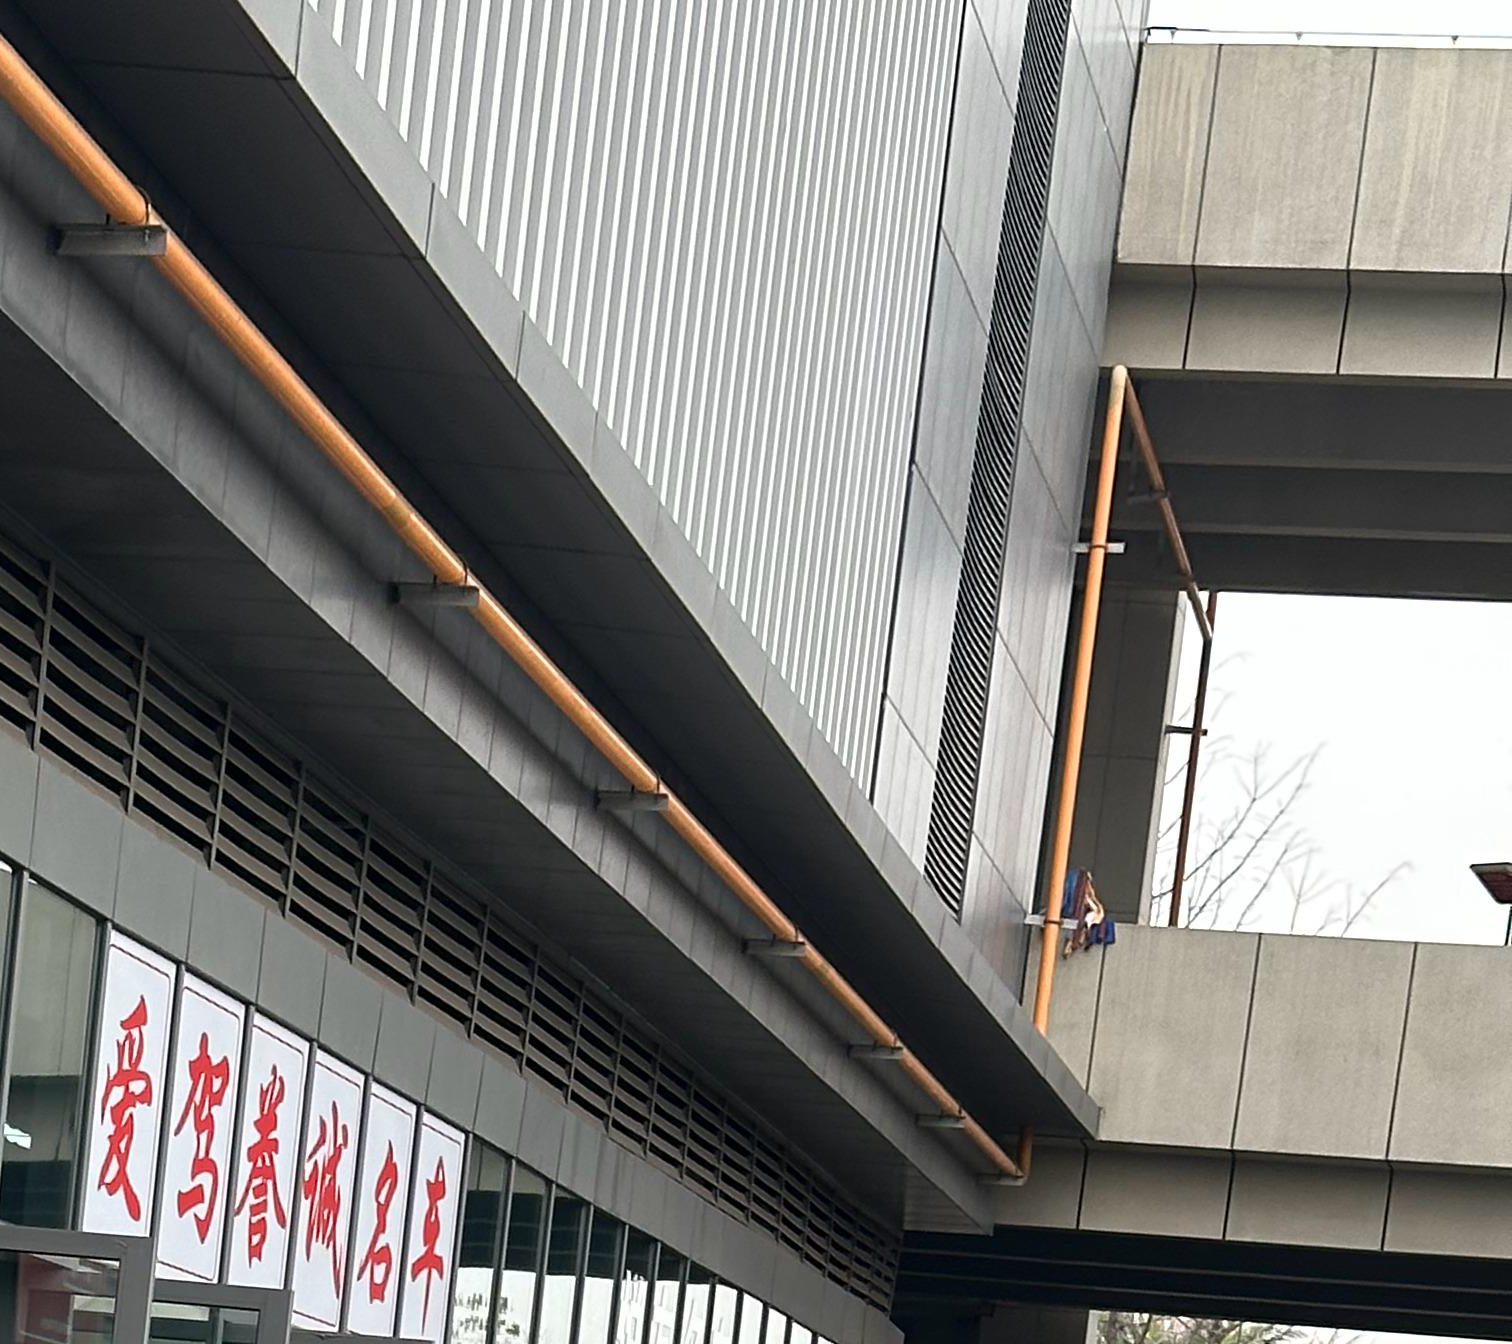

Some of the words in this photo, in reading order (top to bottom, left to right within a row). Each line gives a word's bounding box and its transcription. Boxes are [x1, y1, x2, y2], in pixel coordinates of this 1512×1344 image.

[97, 994, 445, 1334] 爱驾誉诚名车
